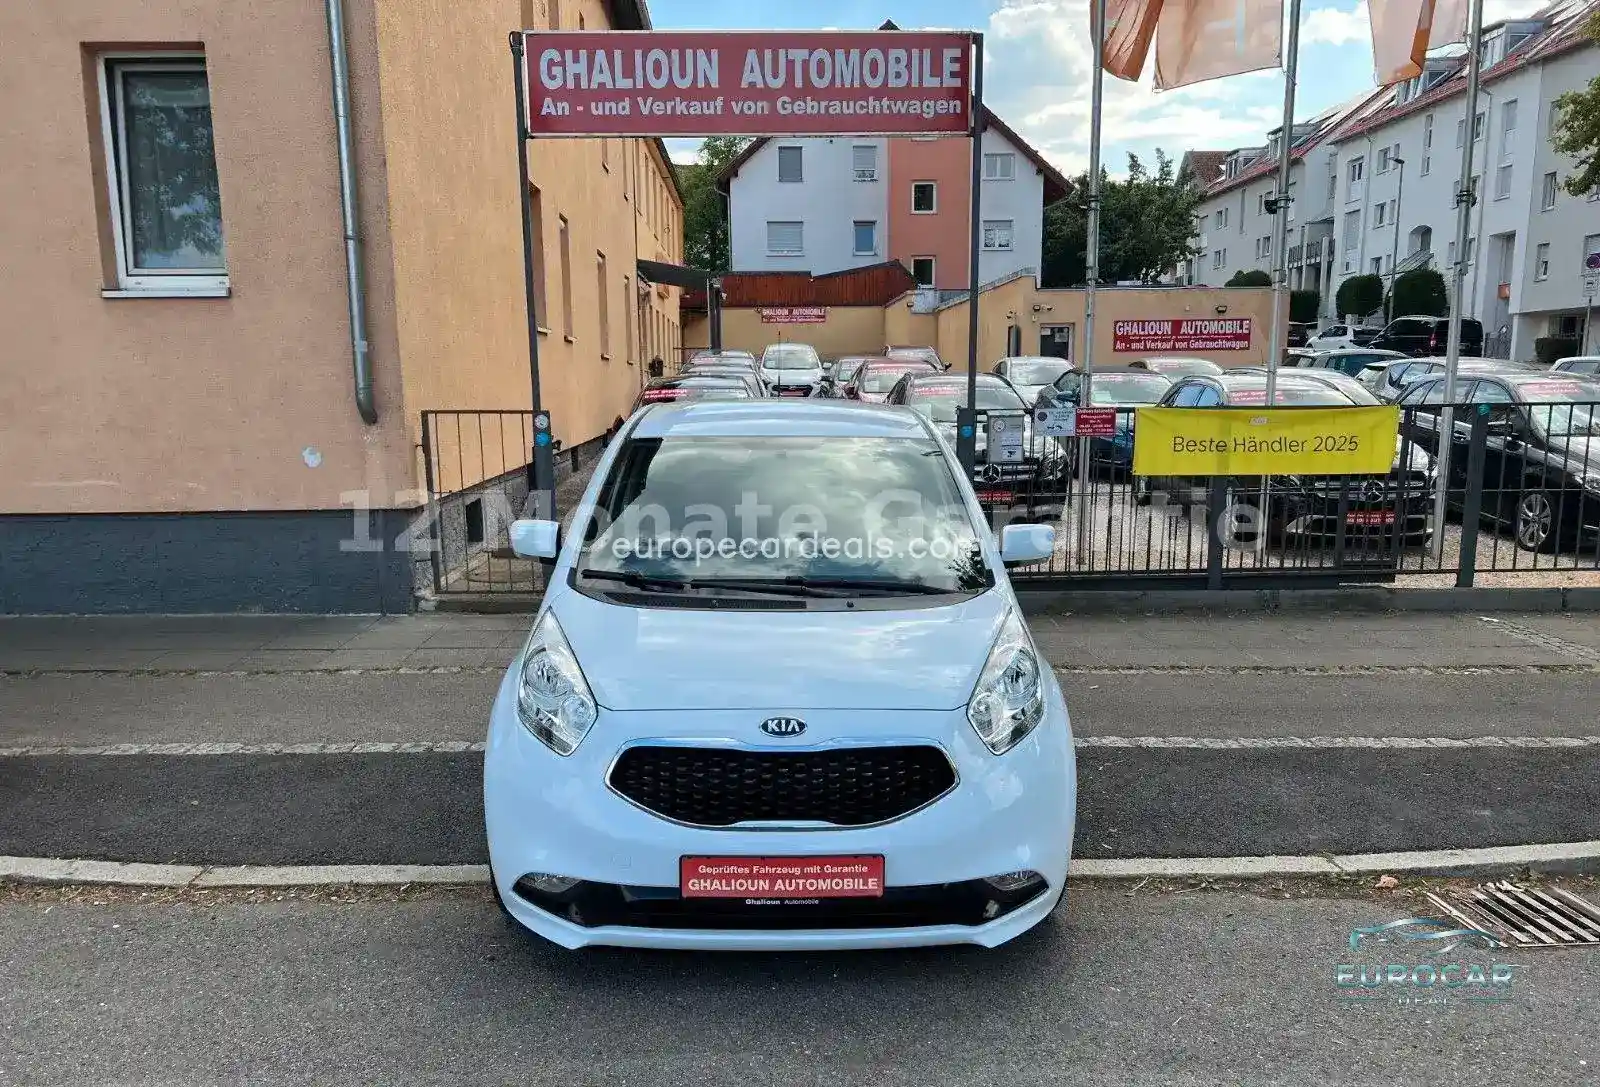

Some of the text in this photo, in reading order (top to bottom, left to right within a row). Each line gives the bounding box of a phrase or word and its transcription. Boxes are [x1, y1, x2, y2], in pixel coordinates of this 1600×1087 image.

[539, 47, 962, 90] GHALIOUN AUTOMOBILE
[540, 97, 570, 116] An
[590, 97, 631, 116] und
[636, 96, 724, 116] Verkauf
[730, 100, 769, 116] von
[776, 96, 962, 119] Gebrauchtwagen
[1115, 320, 1250, 335] GHALIOUN AUTOMOBILE
[1146, 339, 1173, 350] Verkauf
[1189, 339, 1249, 351] Gebrauchtwagen
[1172, 435, 1359, 453] Beste Händler 2025
[766, 719, 801, 733] KIA
[698, 863, 869, 876] Geprüftes Fahrzeug mit Garantie
[687, 877, 879, 891] GHALIOUN AUTOMOBILE
[745, 898, 820, 906] Ghalioun Automobile
